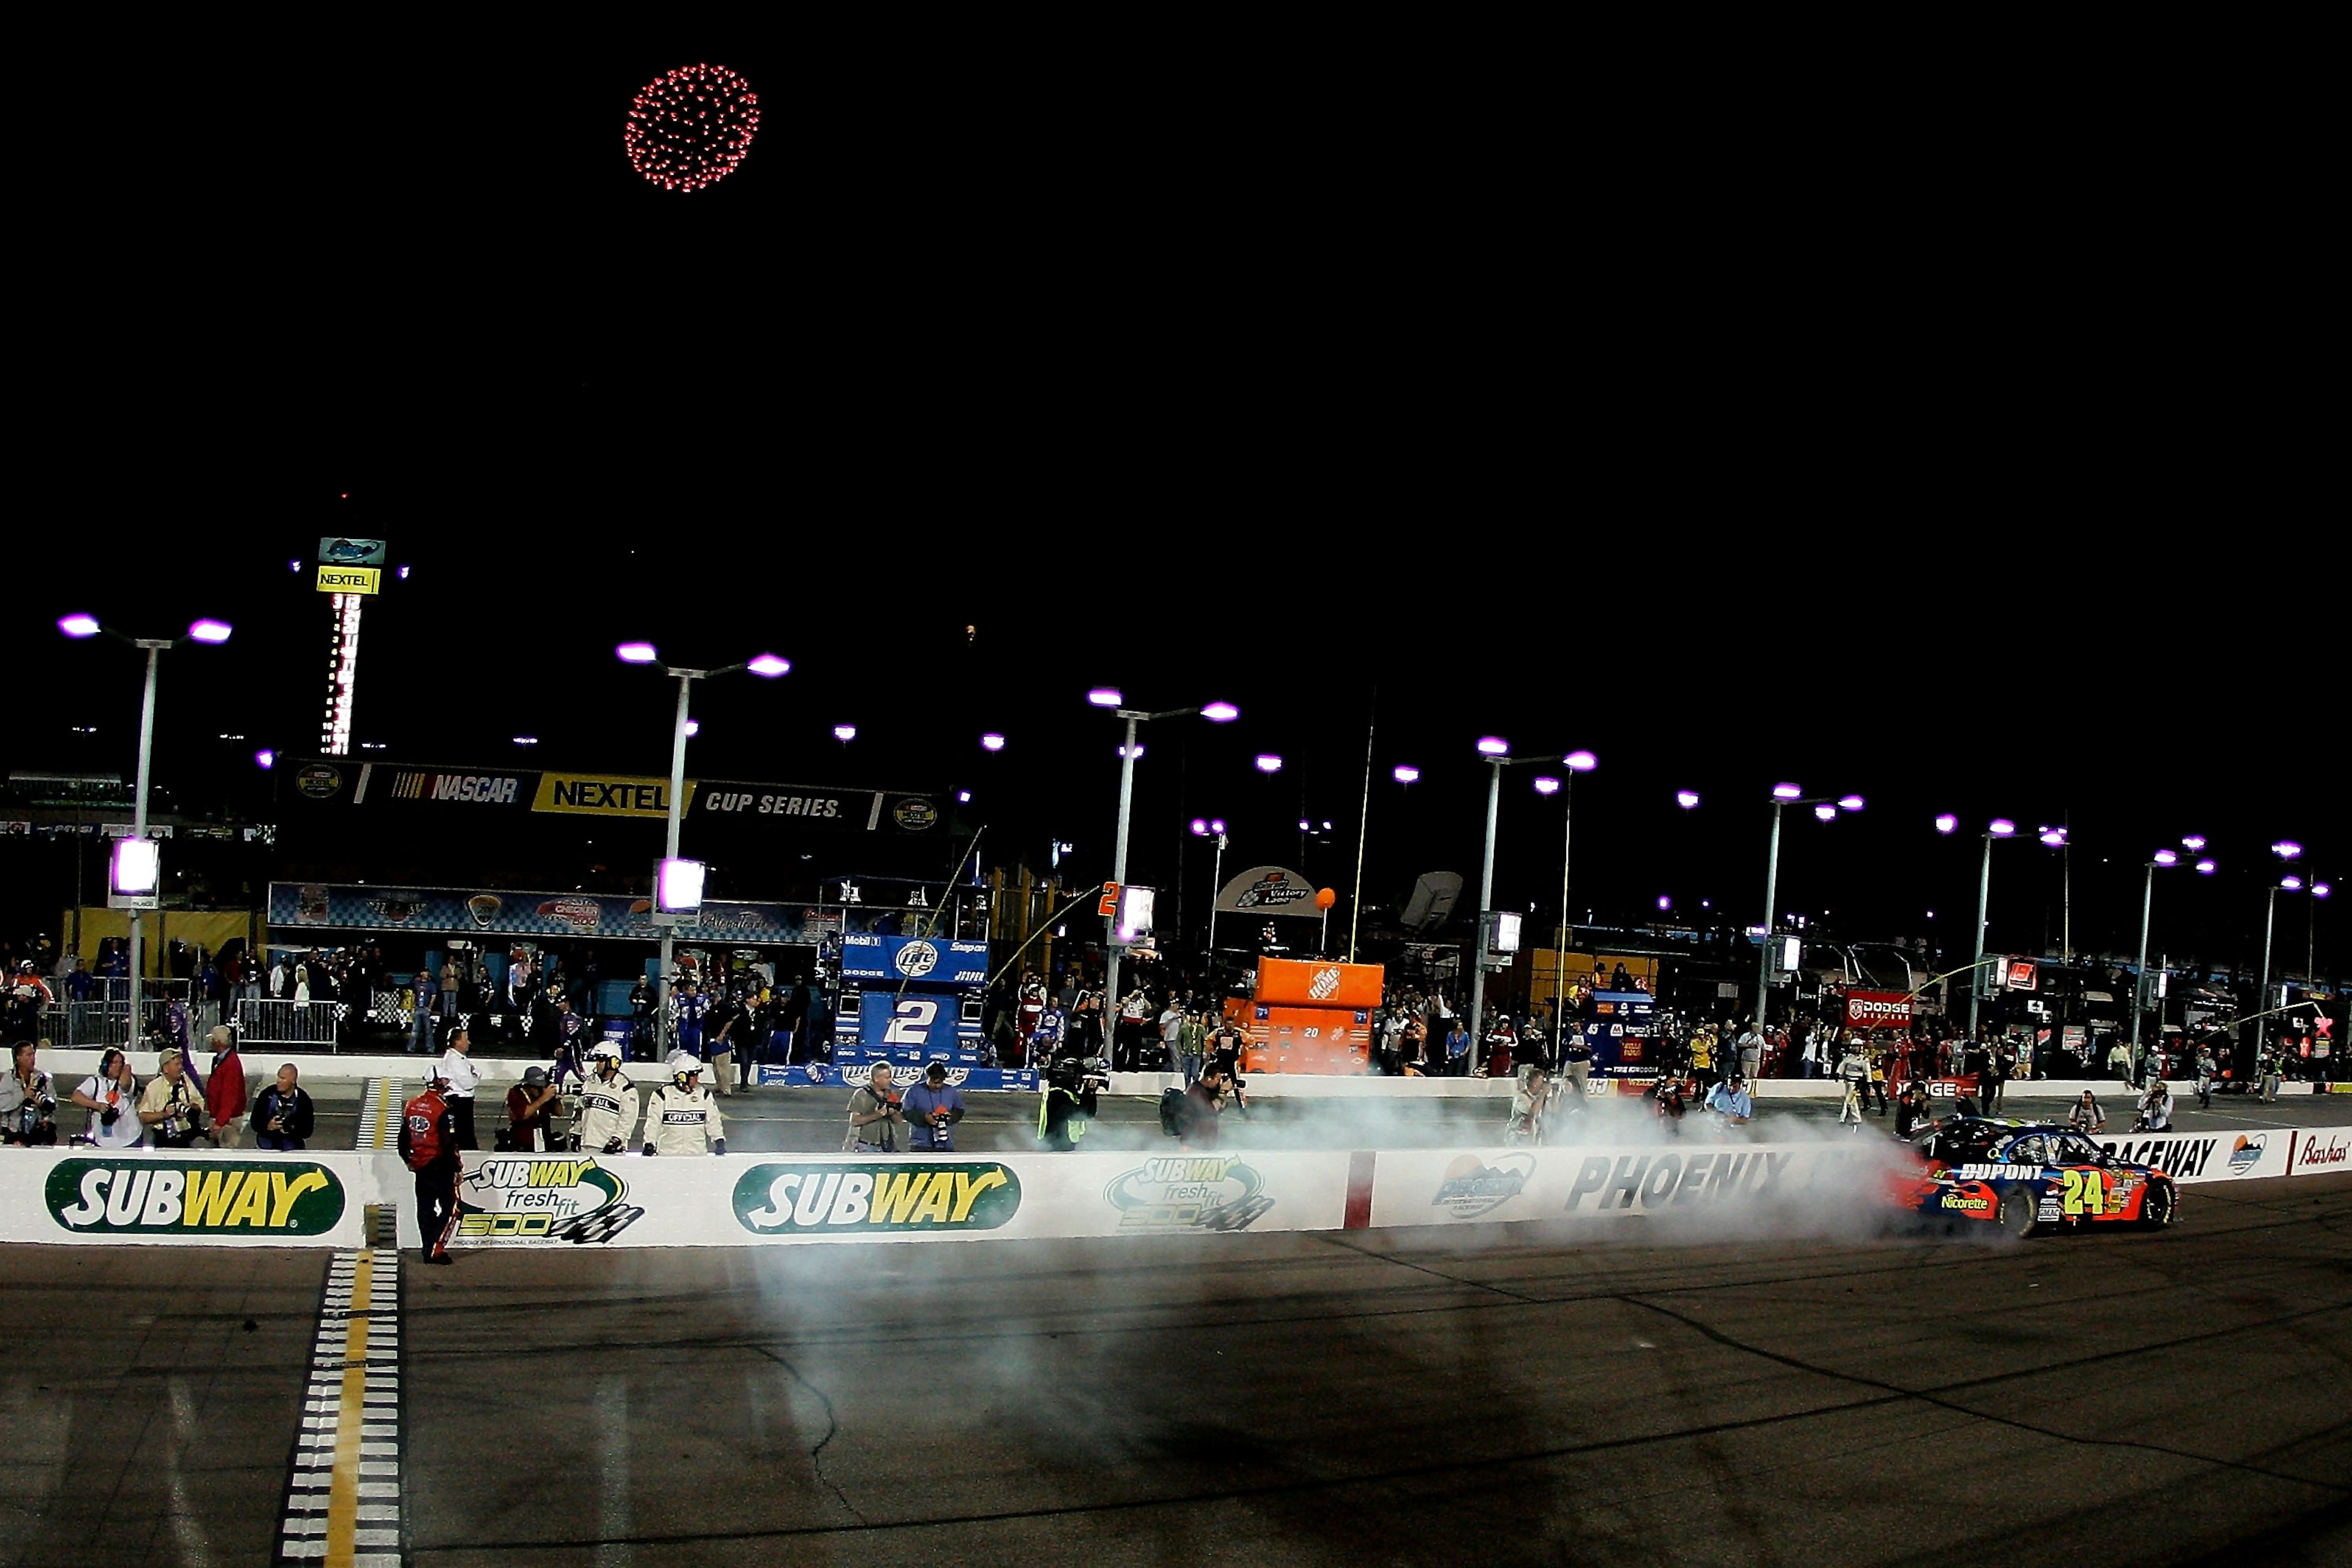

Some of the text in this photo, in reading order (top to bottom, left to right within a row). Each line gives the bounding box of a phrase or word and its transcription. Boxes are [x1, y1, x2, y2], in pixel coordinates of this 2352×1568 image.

[320, 574, 369, 586] NEXTEL
[431, 774, 517, 802] NASCAR
[554, 780, 670, 810] NEXTEL
[706, 792, 753, 812] CUP
[1270, 889, 1307, 897] Victory
[845, 935, 870, 946] Mobil
[1309, 966, 1341, 1000] HOME
[1313, 969, 1325, 982] THE
[1863, 1001, 1910, 1013] DODGE
[883, 1000, 938, 1044] 2
[1303, 1027, 1319, 1038] 20
[668, 1113, 701, 1122] OFFICIAL
[471, 1157, 597, 1191] SUBWAY
[1137, 1155, 1242, 1184] SUBWAY
[1564, 1151, 1795, 1211] PHOENIX
[1959, 1164, 2045, 1180] DUPONT
[61, 1167, 329, 1227] SUBWAY
[506, 1190, 580, 1218] fresh fit
[747, 1166, 1008, 1230] SUBWAY
[1164, 1183, 1226, 1208] fresh fit
[1941, 1196, 1989, 1210] Nicorette
[2062, 1169, 2104, 1215] 24
[458, 1213, 552, 1236] 500
[1120, 1204, 1202, 1226] 500
